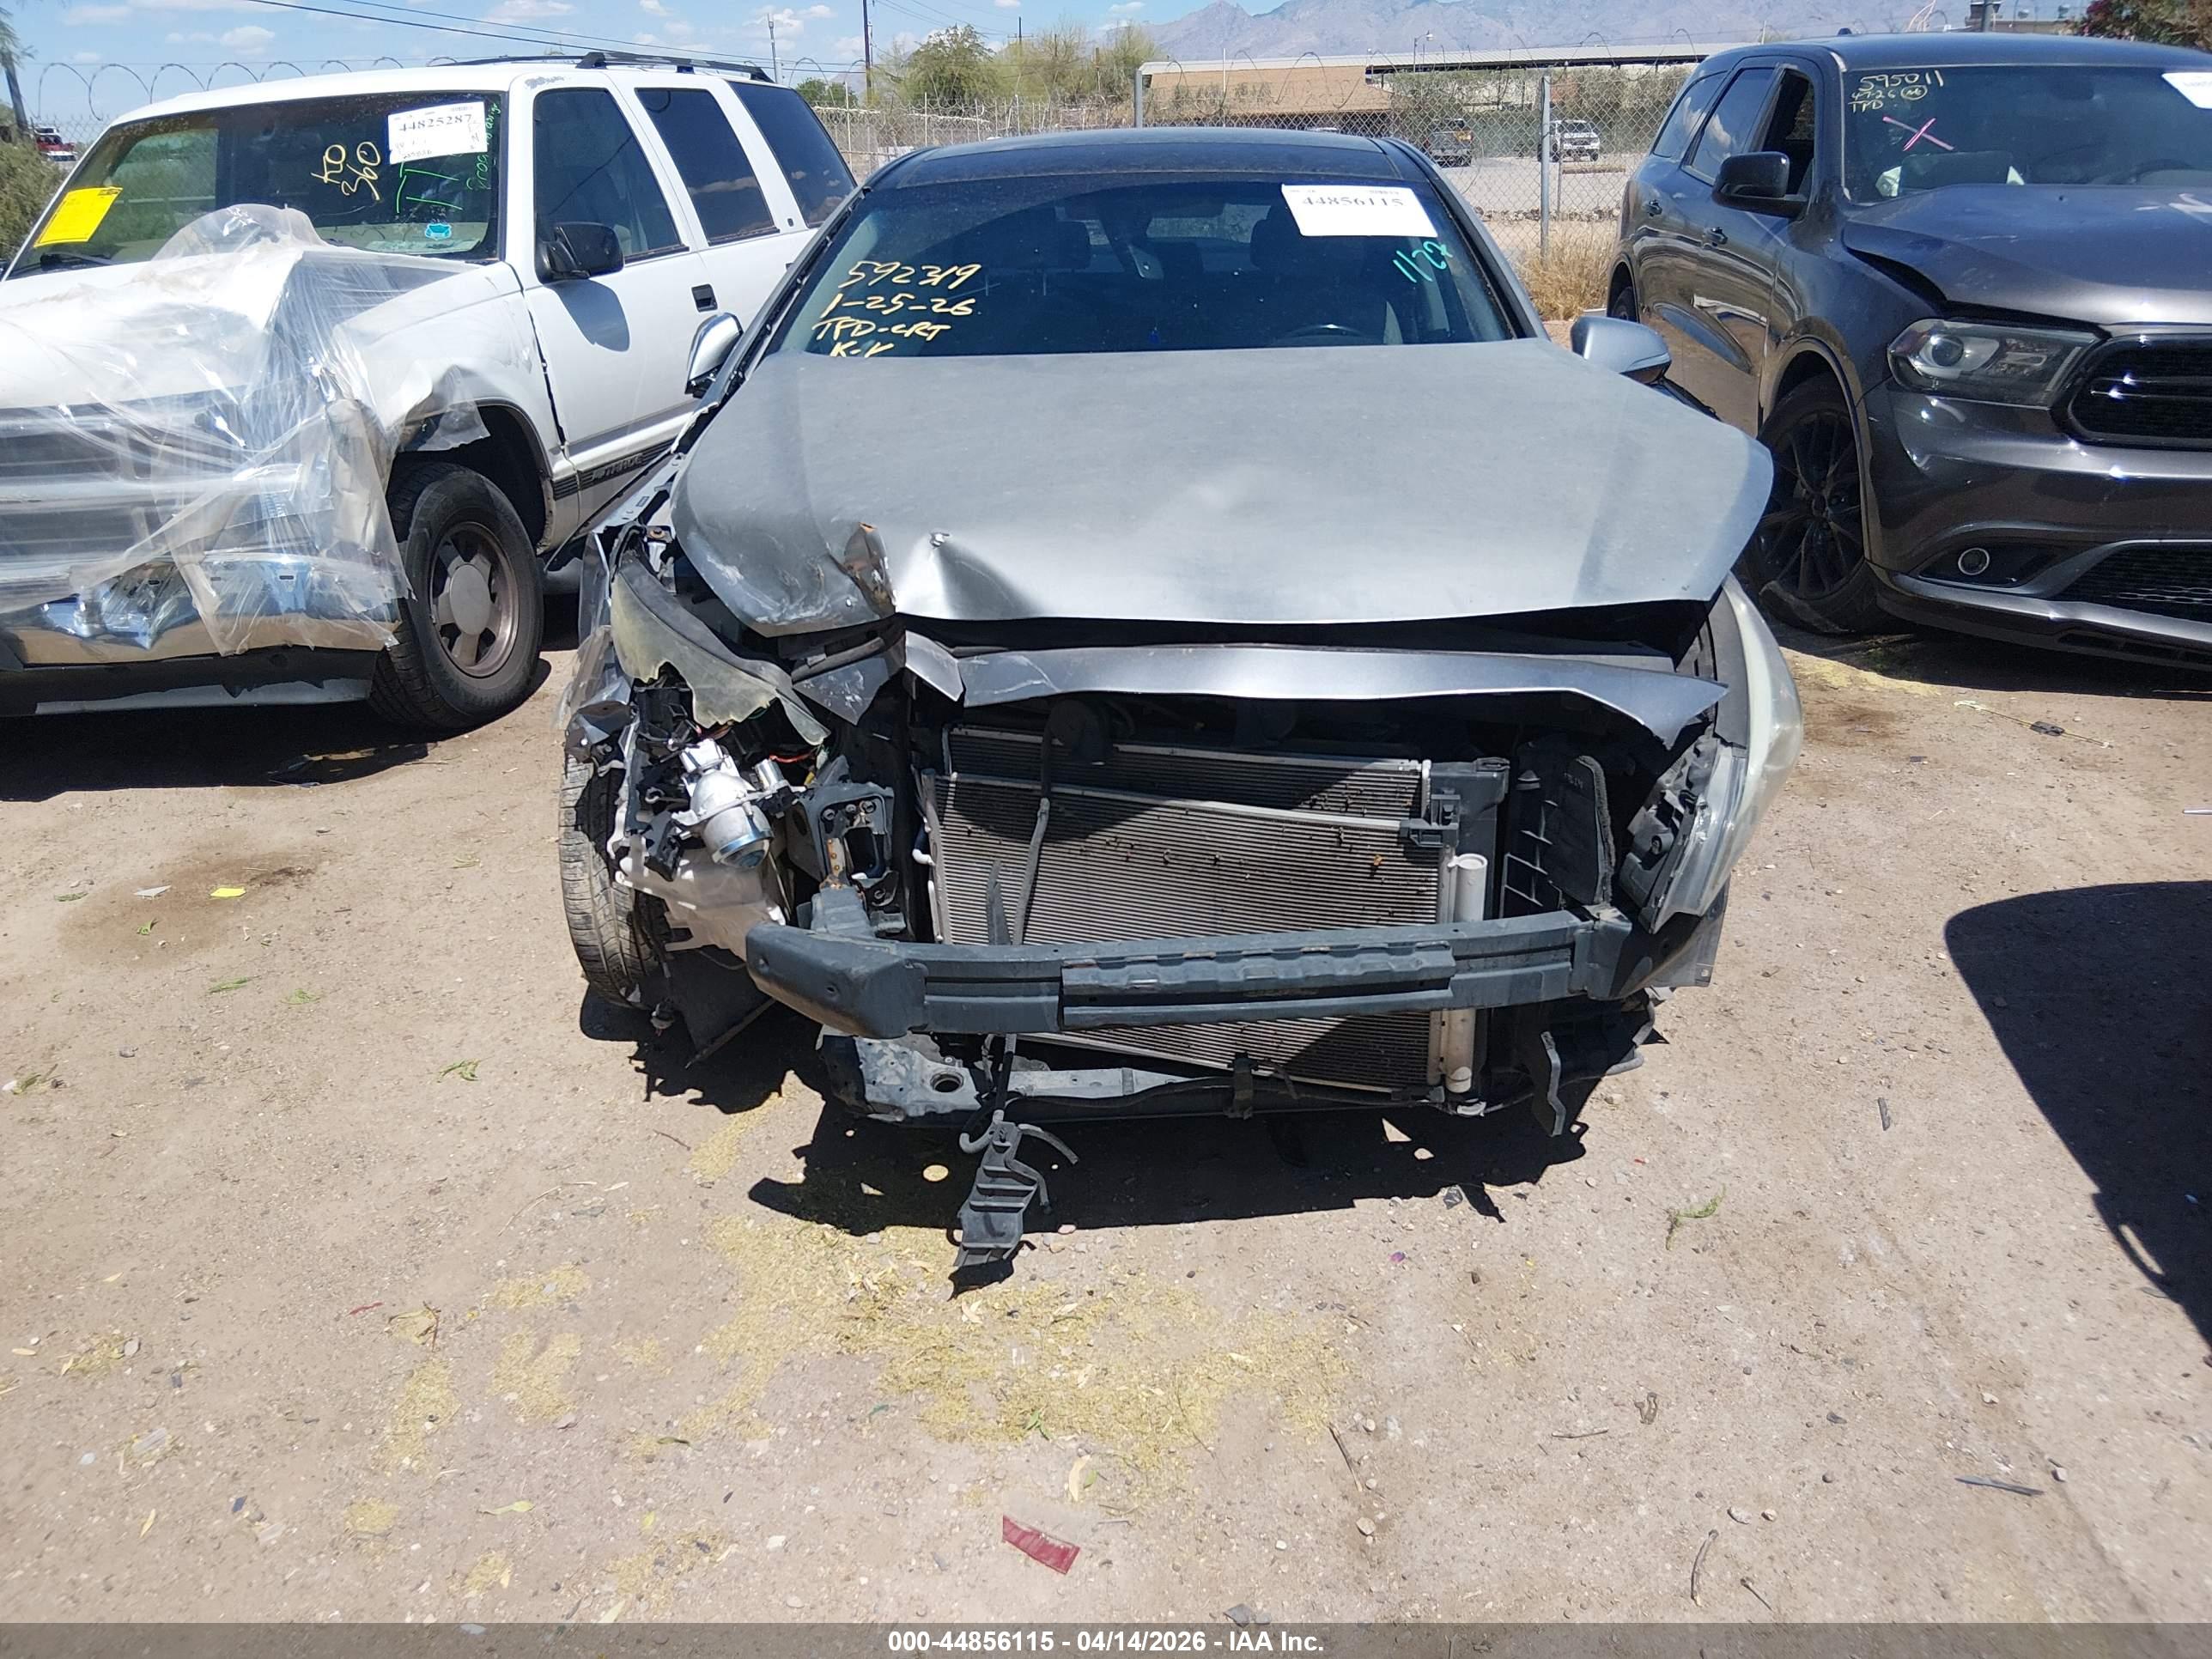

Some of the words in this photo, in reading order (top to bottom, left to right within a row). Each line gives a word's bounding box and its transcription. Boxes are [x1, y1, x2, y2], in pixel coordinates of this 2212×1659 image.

[1858, 70, 1944, 92] 595011
[398, 113, 473, 132] 44825287
[1302, 196, 1405, 207] 44856115
[837, 261, 982, 289] 592319
[820, 293, 976, 319] 1-25-26
